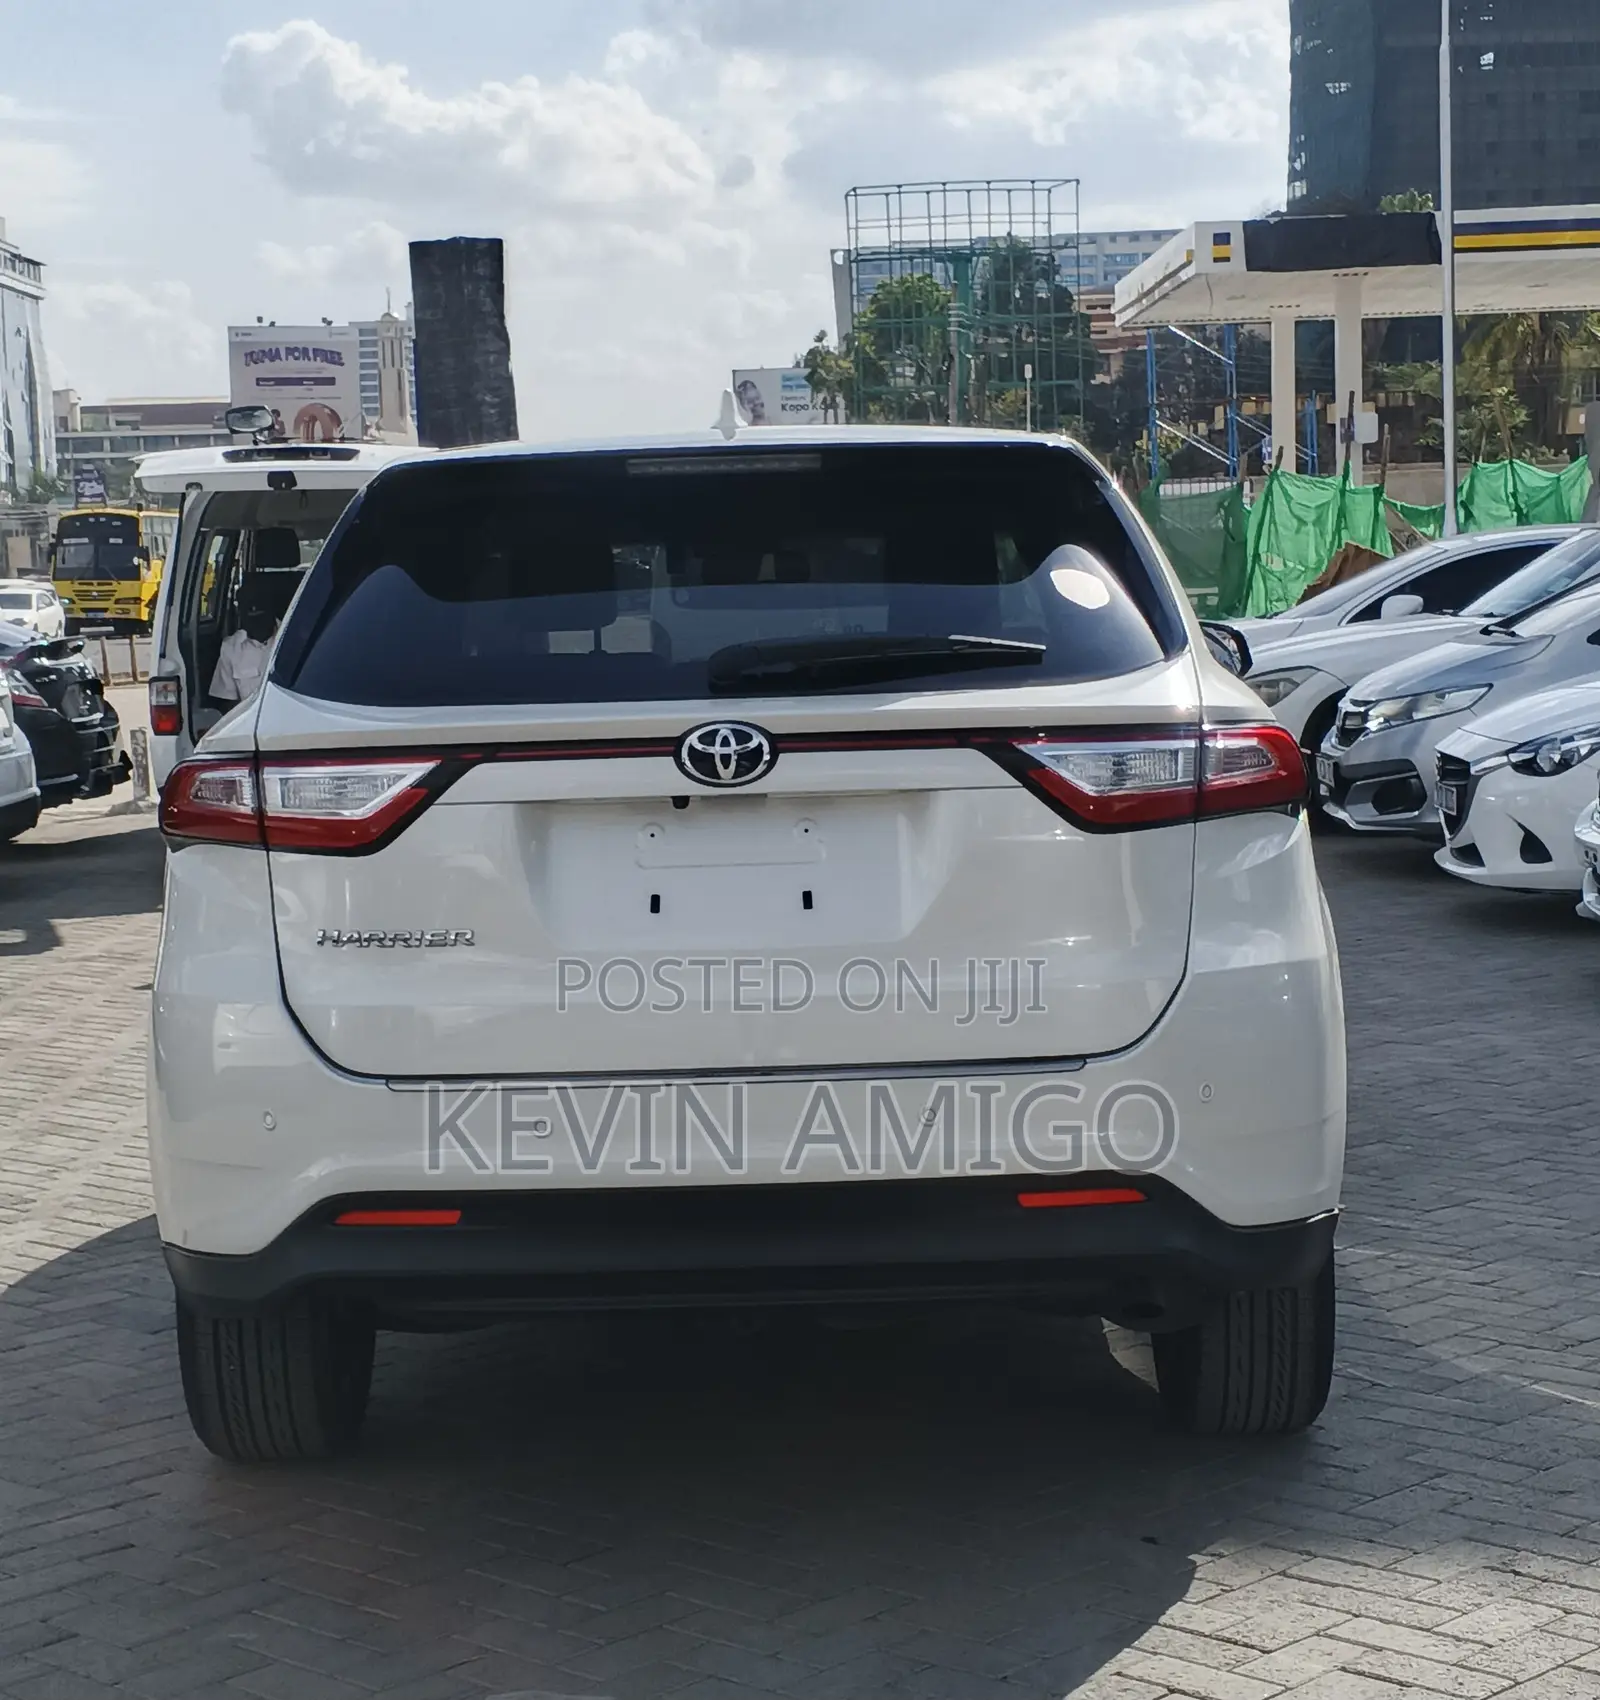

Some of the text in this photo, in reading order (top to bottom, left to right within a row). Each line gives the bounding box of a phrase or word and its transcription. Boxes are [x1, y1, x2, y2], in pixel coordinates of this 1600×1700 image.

[285, 346, 311, 361] FOR
[312, 347, 345, 366] FREE
[781, 403, 809, 414] Kopo
[316, 928, 475, 948] HARRIER
